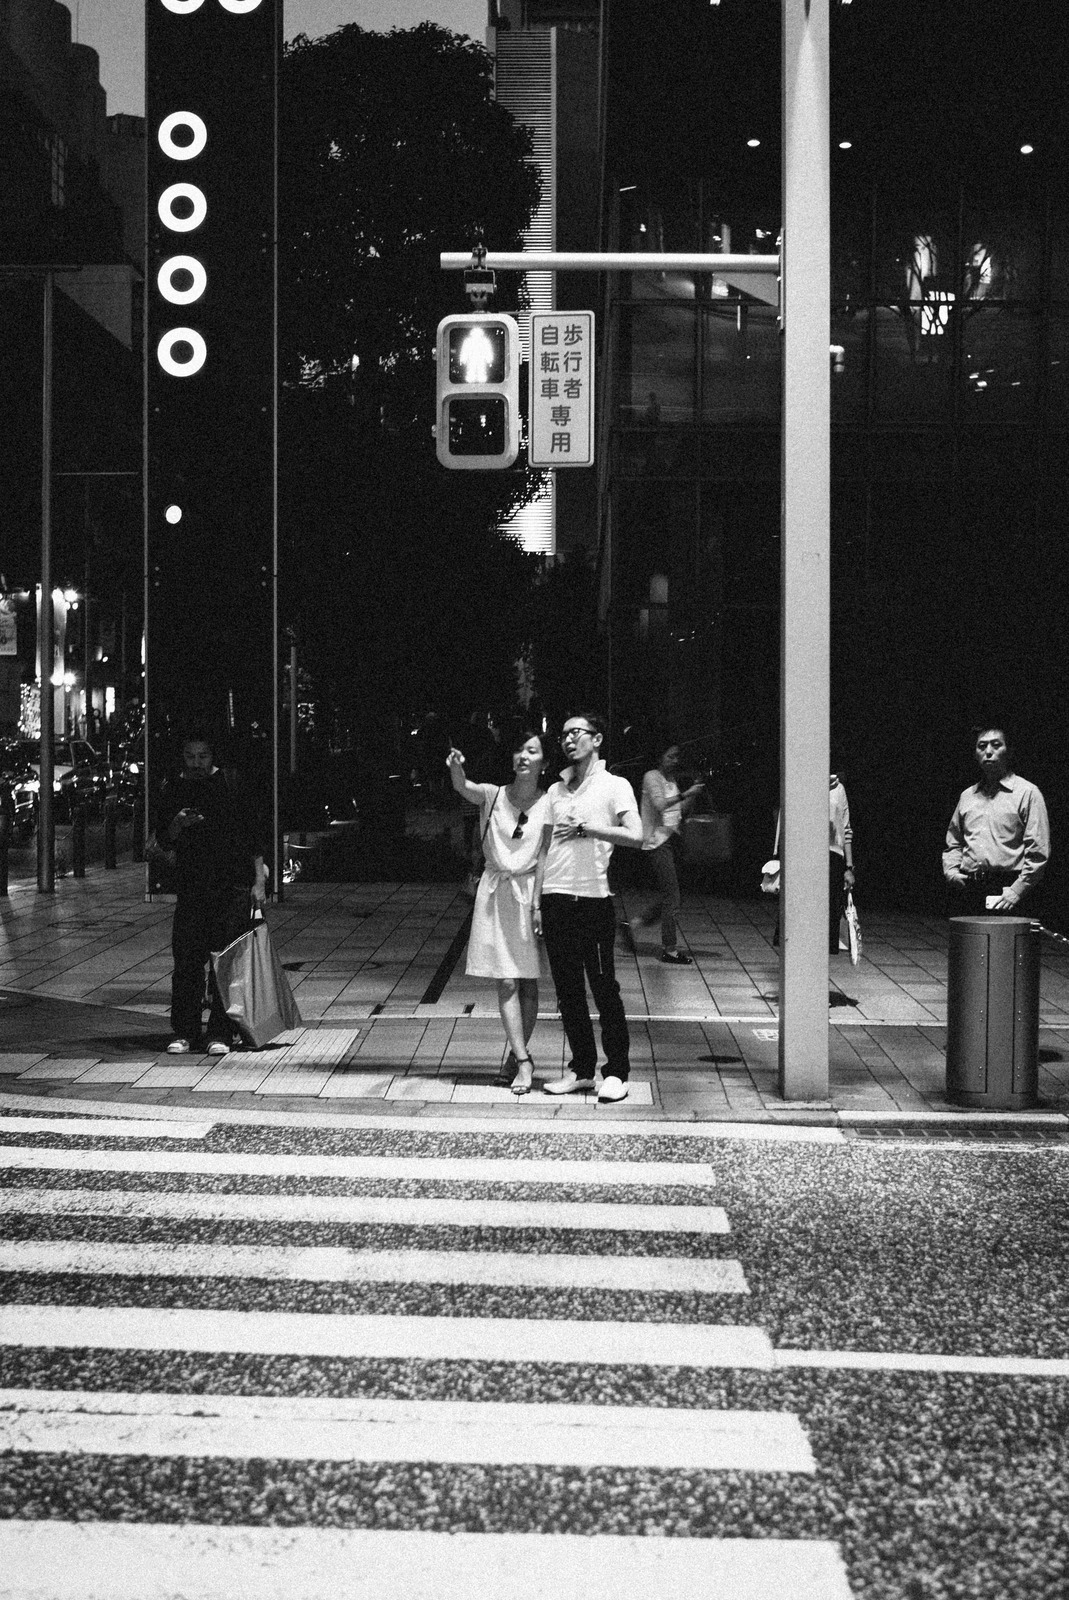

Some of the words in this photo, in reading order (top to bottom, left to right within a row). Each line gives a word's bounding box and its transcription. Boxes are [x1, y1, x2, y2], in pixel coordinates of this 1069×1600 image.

[540, 324, 560, 400] 自転車
[563, 323, 583, 399] 歩行者
[550, 404, 572, 453] 専用
